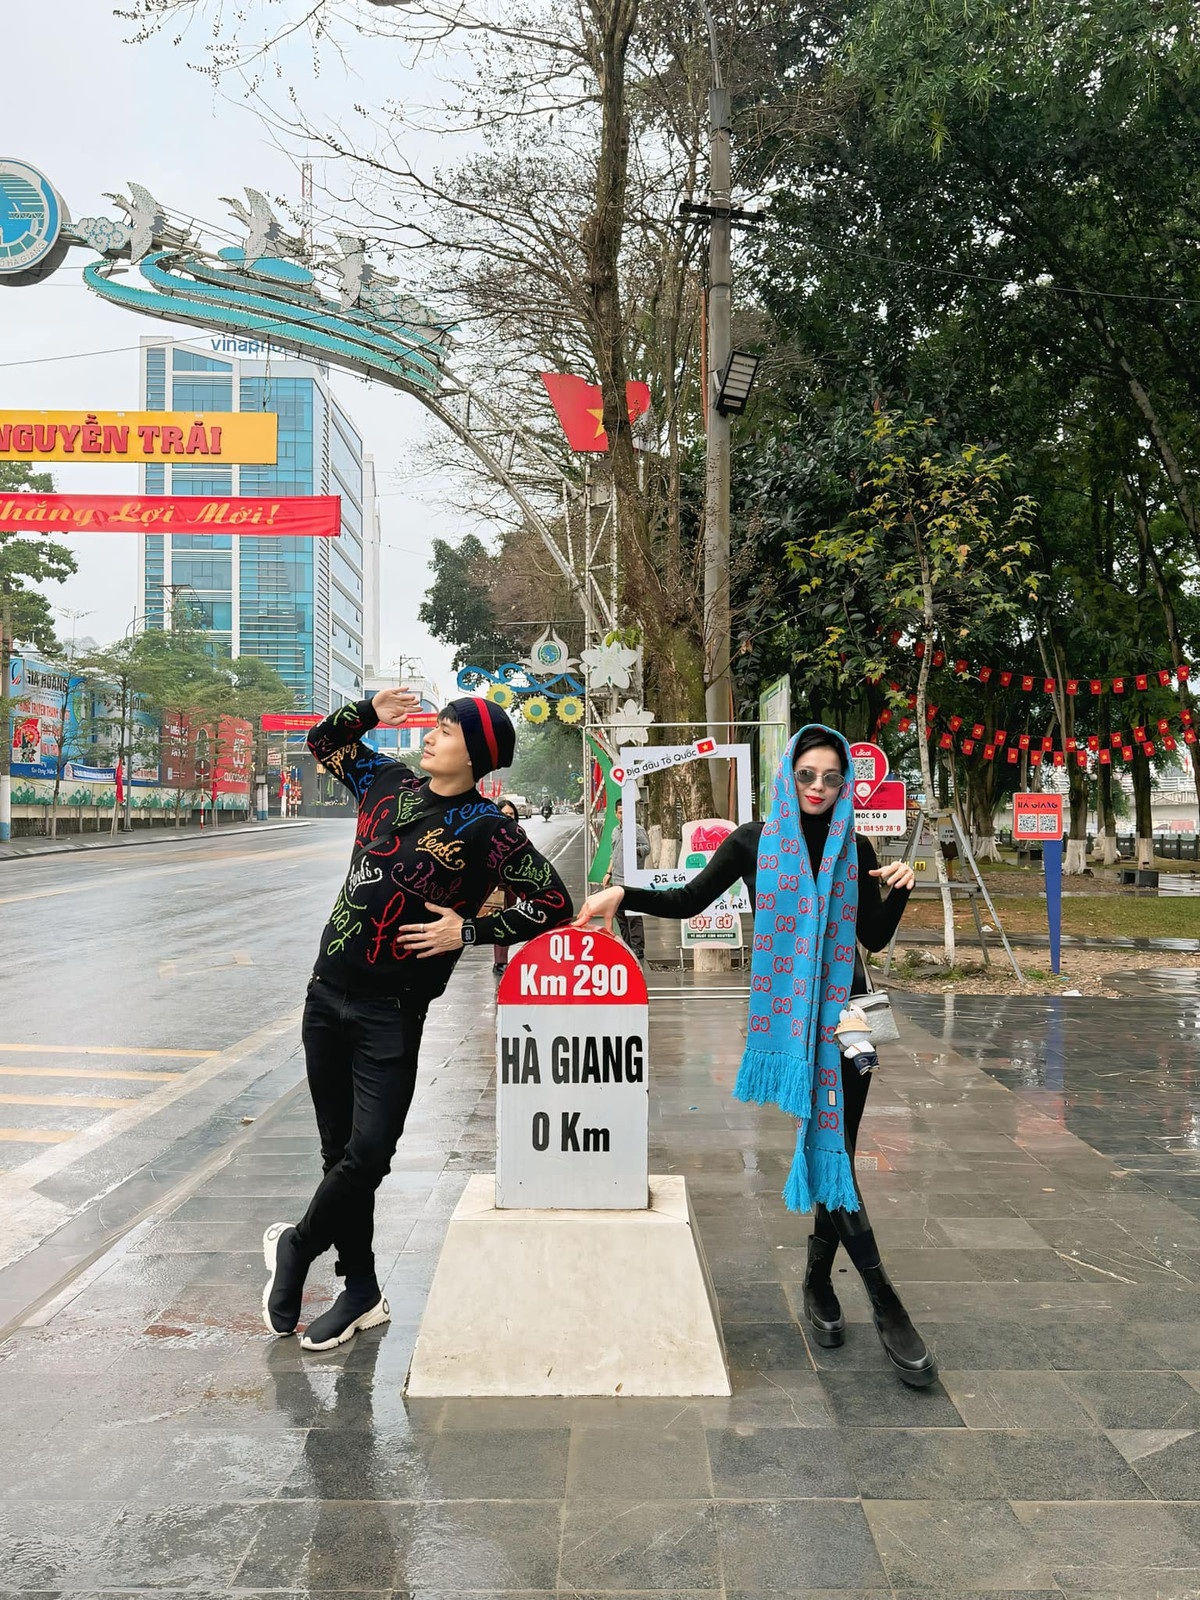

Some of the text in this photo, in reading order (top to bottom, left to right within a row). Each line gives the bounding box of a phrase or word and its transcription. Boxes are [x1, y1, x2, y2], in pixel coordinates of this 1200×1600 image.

[0, 413, 222, 454] NGUYỄN TRÃI
[0, 500, 280, 528] hắng Lợi Mới!
[626, 769, 640, 777] Địa
[674, 748, 697, 760] Quốc
[654, 874, 669, 884] Đã
[715, 898, 748, 910] rồi nè!
[689, 912, 734, 932] CỘT CỜ
[550, 935, 594, 962] QL 2
[520, 964, 628, 996] Km 290
[502, 1024, 644, 1084] HÀ GIANG
[532, 1112, 610, 1152] 0 Km
